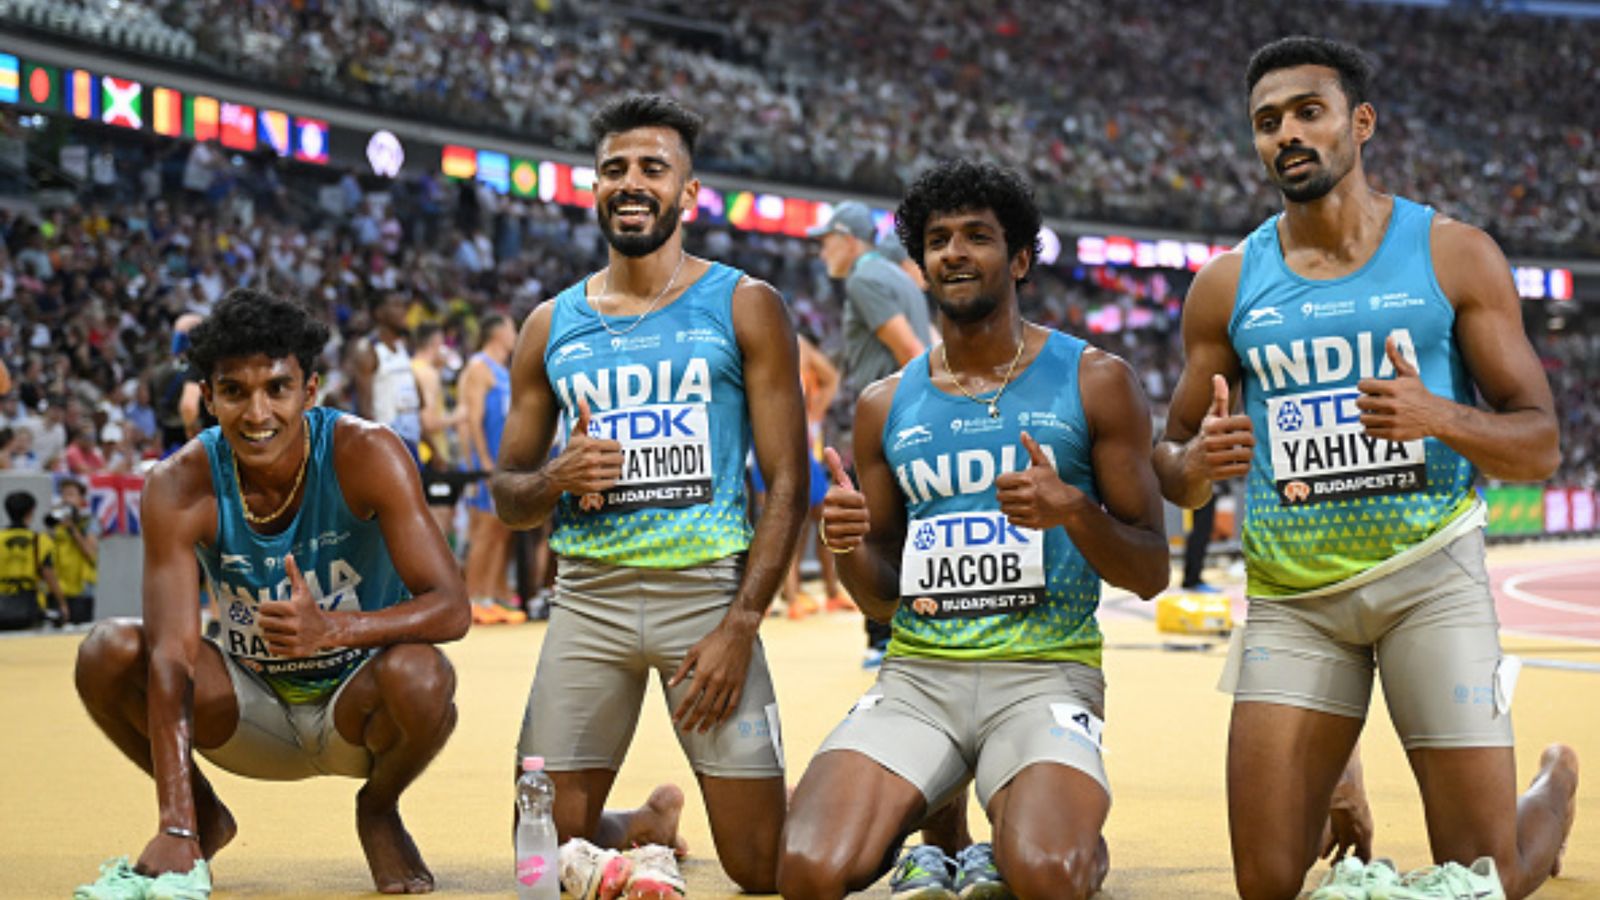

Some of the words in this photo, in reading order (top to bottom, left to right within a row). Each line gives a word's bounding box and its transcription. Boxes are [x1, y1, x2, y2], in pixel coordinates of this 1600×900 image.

[1247, 328, 1420, 392] INDIA
[556, 358, 711, 418] INDIA
[602, 407, 696, 441] TDK
[1300, 392, 1362, 428] TD
[619, 444, 704, 480] ATHODI
[1282, 432, 1409, 473] YAHIYA
[936, 516, 1030, 548] TDK
[919, 552, 1022, 590] JACOB
